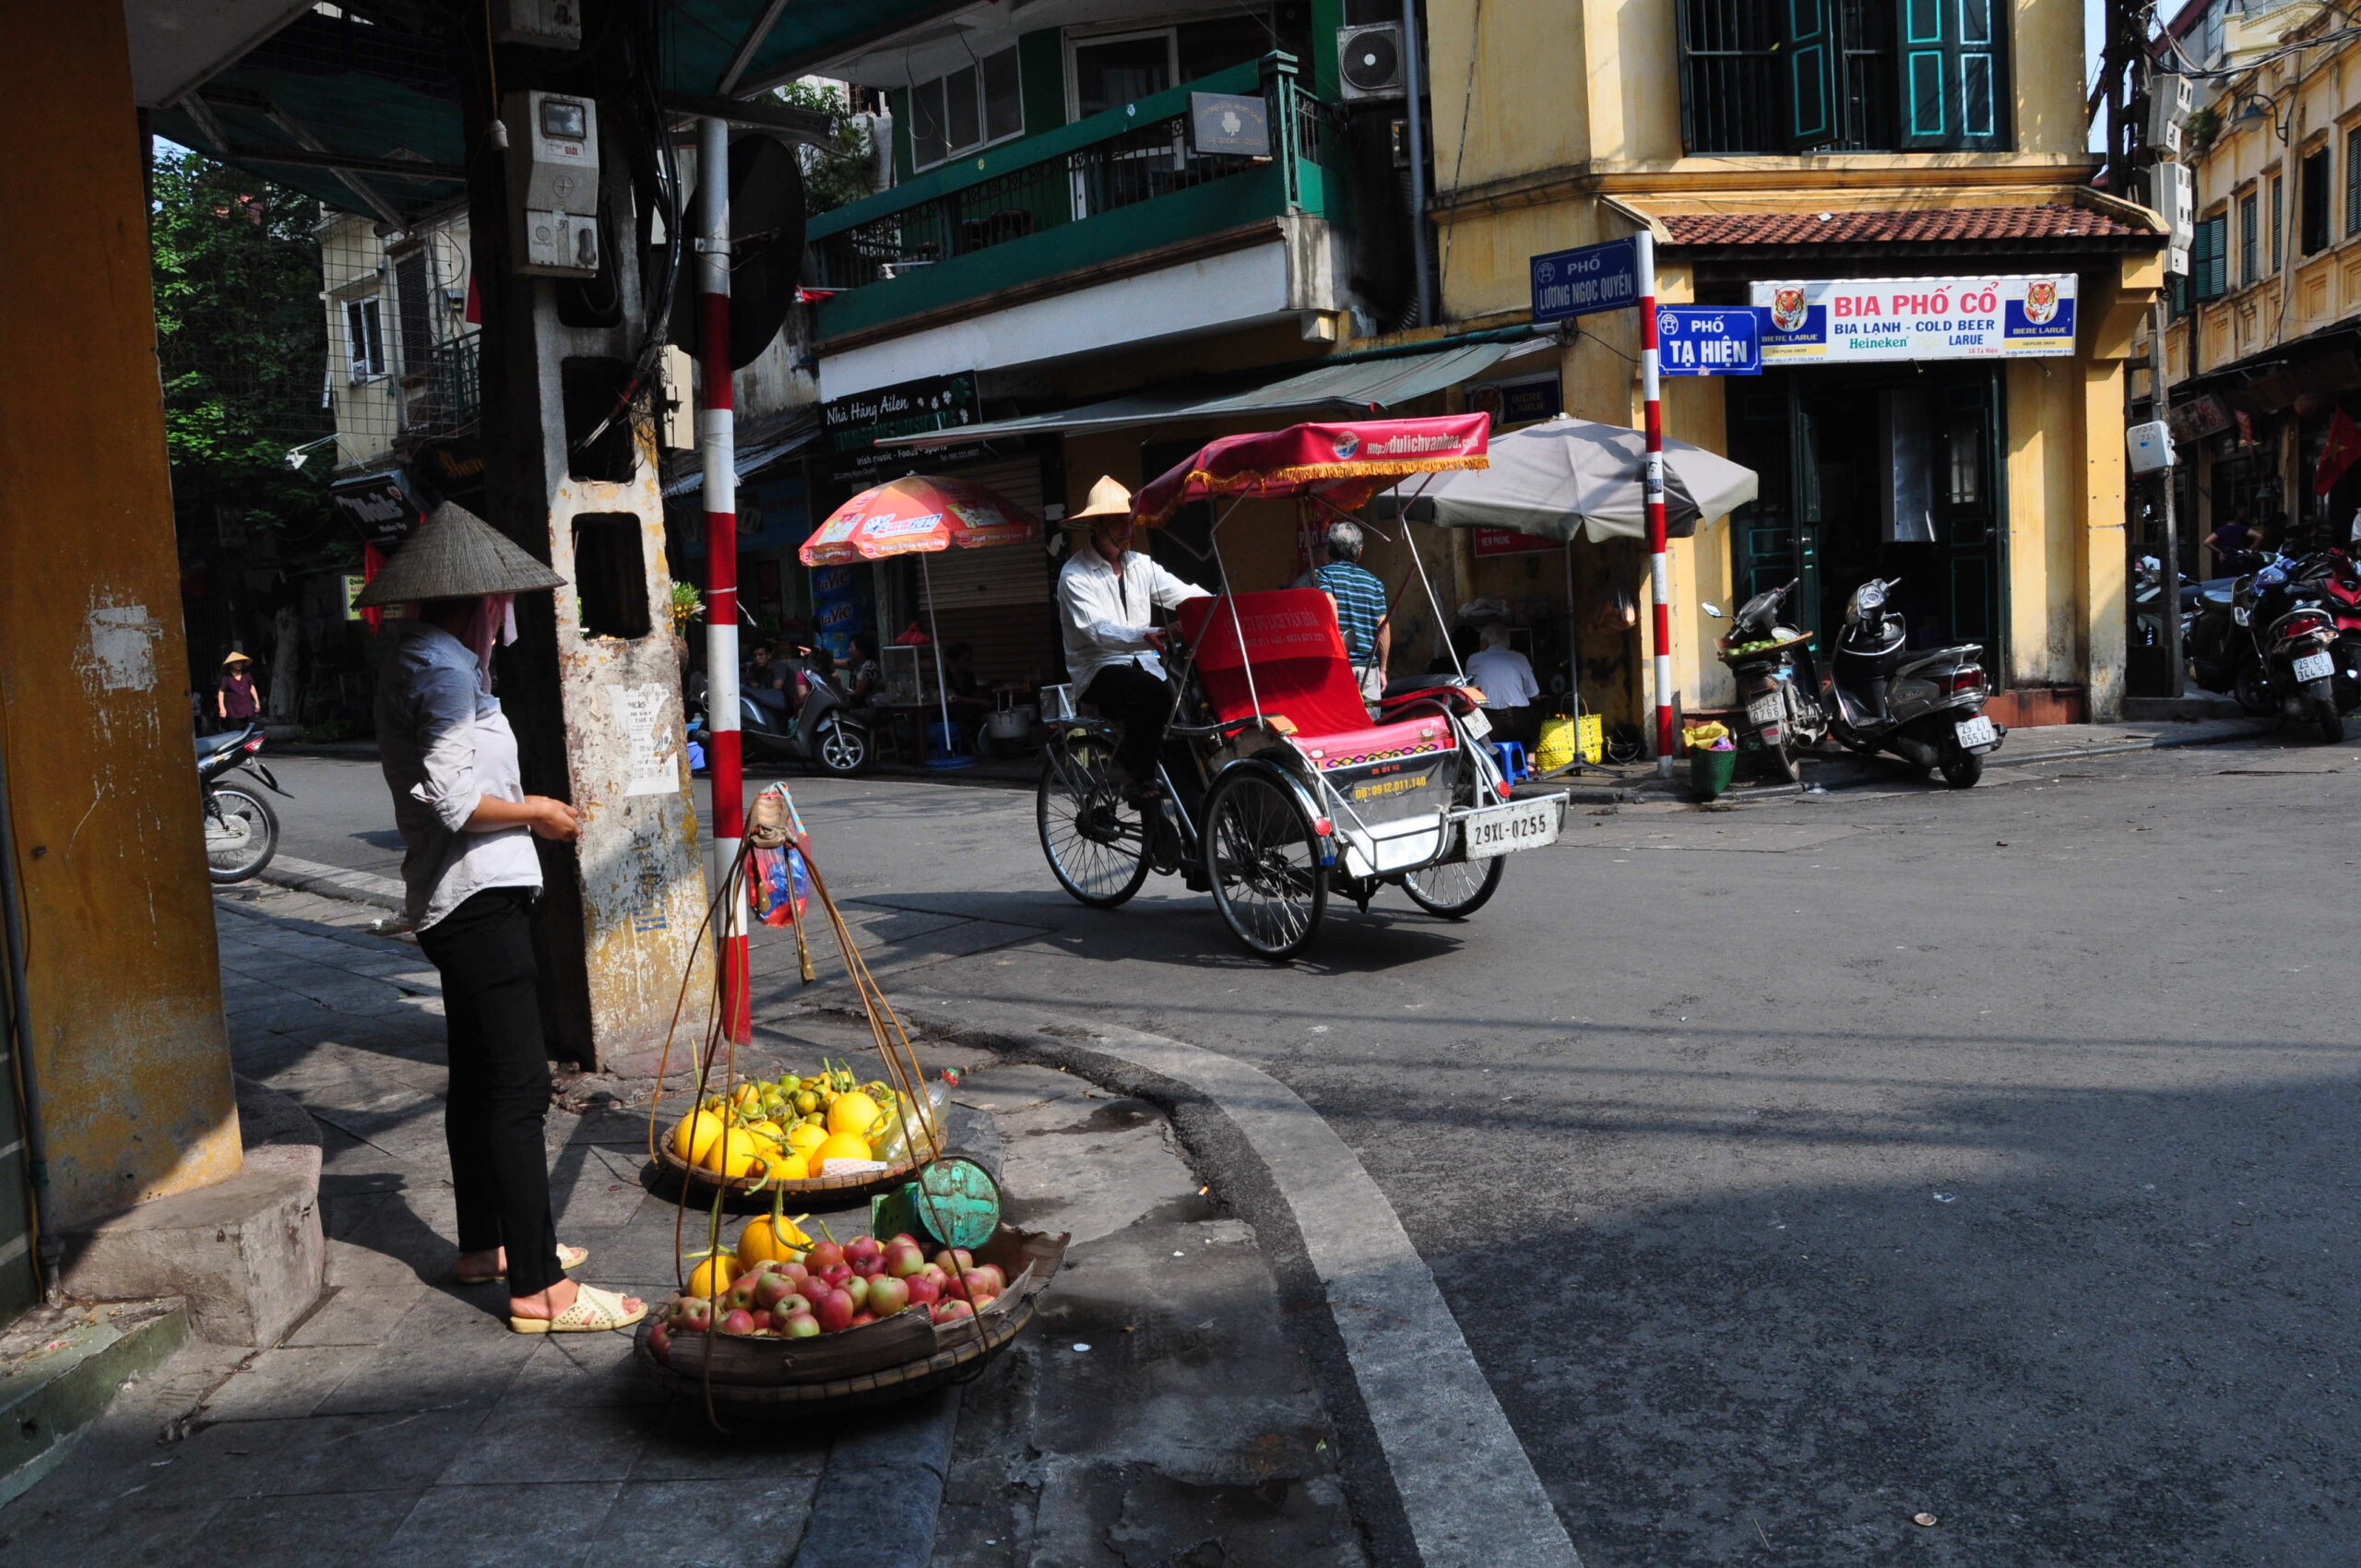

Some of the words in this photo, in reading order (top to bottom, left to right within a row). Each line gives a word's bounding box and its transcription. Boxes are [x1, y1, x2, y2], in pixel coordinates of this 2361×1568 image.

[1567, 253, 1601, 276] PHỐ
[1539, 284, 1571, 311] LƯƠNG
[1572, 279, 1598, 306] NGỌC
[1600, 267, 1632, 302] QUYẾN
[1834, 296, 1881, 317] BIA
[1892, 285, 1952, 315] PHỐ
[1960, 281, 1999, 314] CỔ
[1691, 315, 1725, 333] PHỐ
[1834, 324, 1858, 335] BIA
[1864, 322, 1901, 336] LẠNH
[1916, 320, 1952, 332] COLD
[1958, 319, 1995, 331] BEER
[1788, 333, 1818, 341] LARUE
[1849, 337, 1907, 350] Heineken
[1949, 334, 1984, 346] LARUE
[1669, 340, 1695, 367] TẠ
[1701, 335, 1748, 367] HIỆN
[826, 407, 848, 425] Nhà
[850, 402, 878, 425] Hàng
[880, 394, 909, 414] Ailen
[1753, 707, 1779, 721] 0786
[1476, 814, 1546, 845] 29XL-0255
